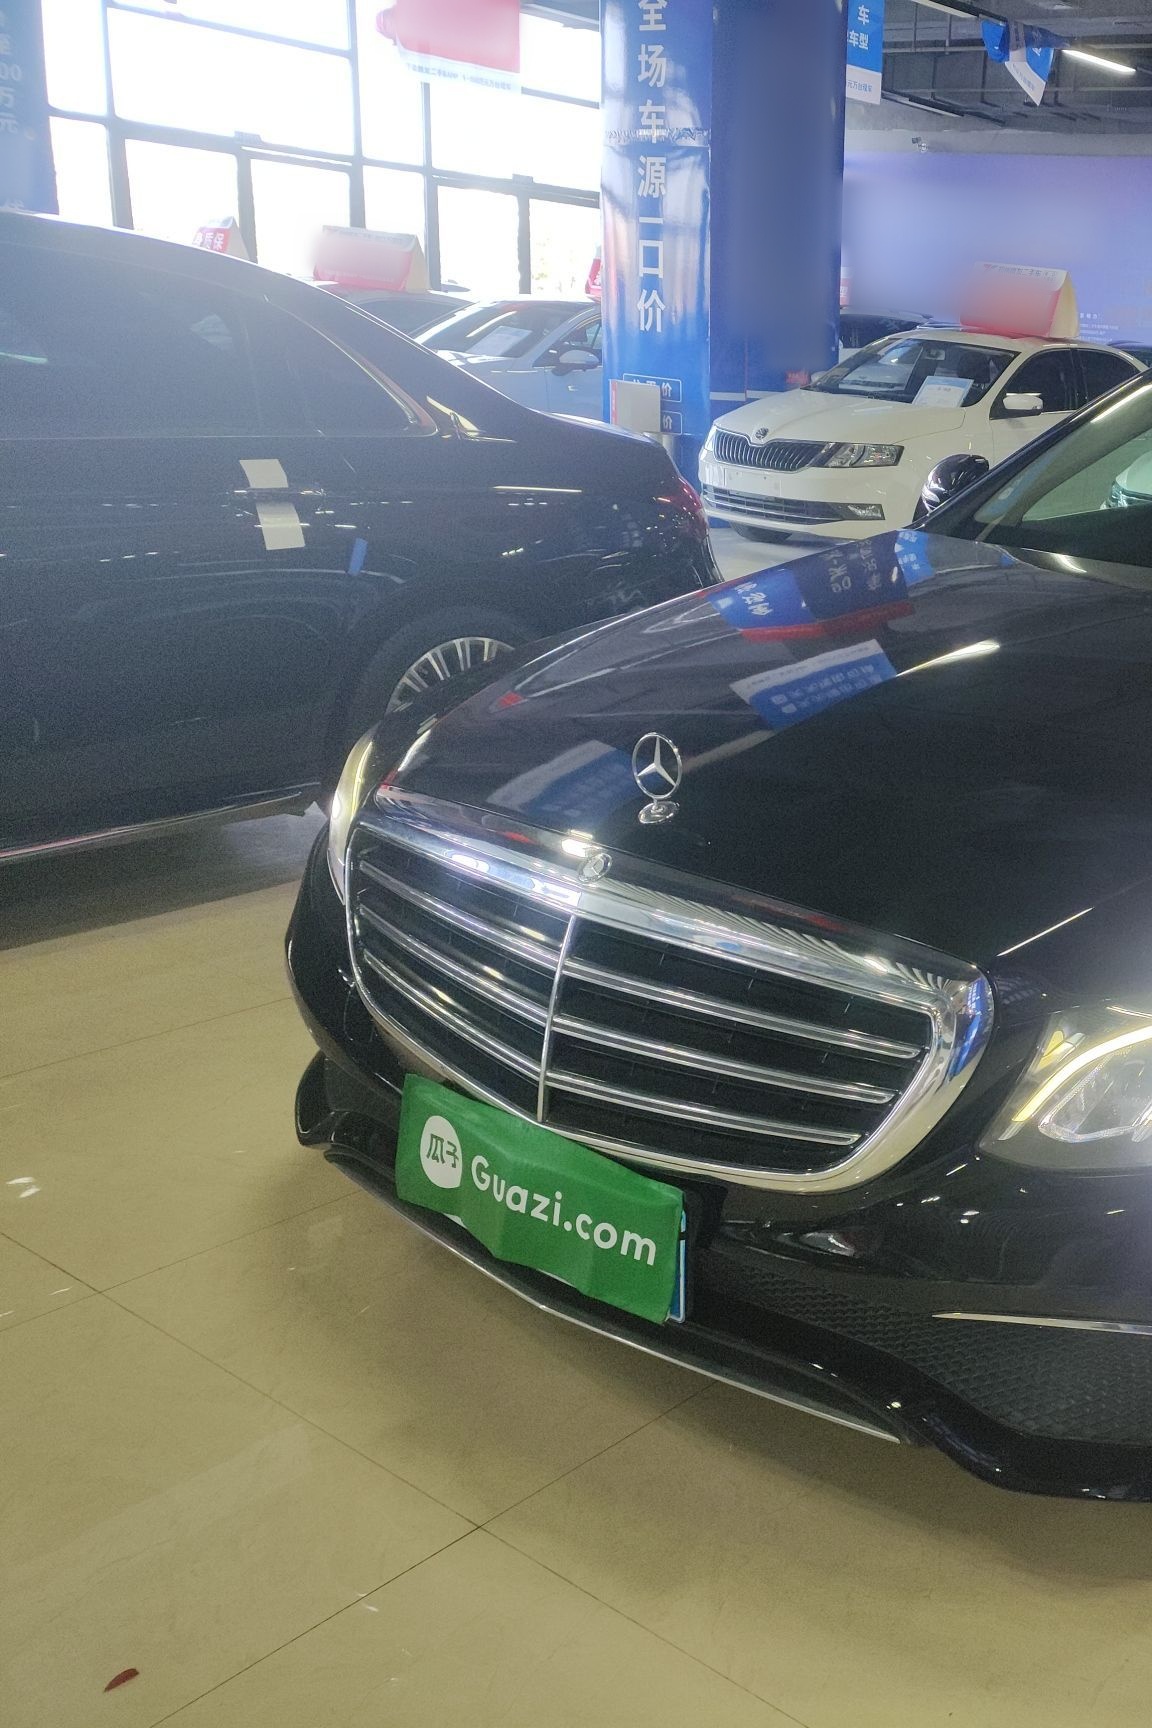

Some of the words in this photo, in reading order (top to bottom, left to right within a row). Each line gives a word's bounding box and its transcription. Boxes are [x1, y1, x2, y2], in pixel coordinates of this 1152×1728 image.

[857, 5, 870, 25] 车
[847, 30, 869, 51] 车型
[637, 0, 668, 333] 全场车源一口价
[426, 1133, 460, 1169] 瓜子
[471, 1155, 657, 1266] Guazi.com
